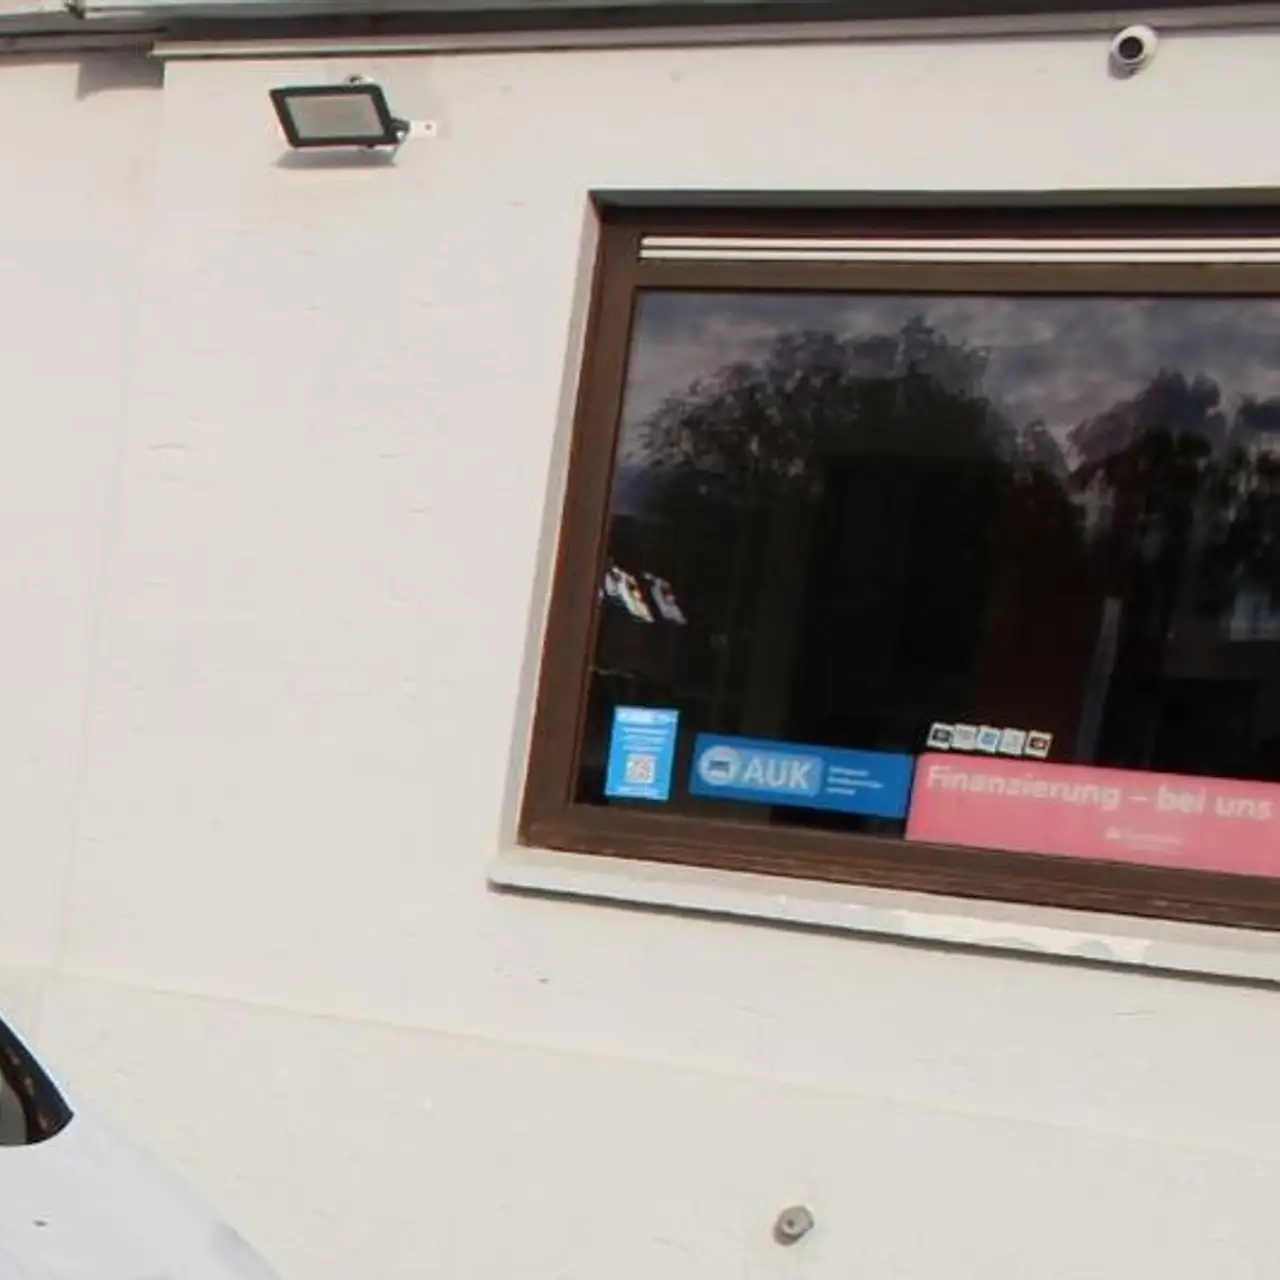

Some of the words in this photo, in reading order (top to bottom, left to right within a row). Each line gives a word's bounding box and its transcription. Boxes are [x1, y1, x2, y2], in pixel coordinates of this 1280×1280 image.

[742, 756, 812, 790] AUK
[927, 765, 1121, 811] Finanzierung
[1155, 785, 1207, 813] bei
[1215, 795, 1273, 820] uns
